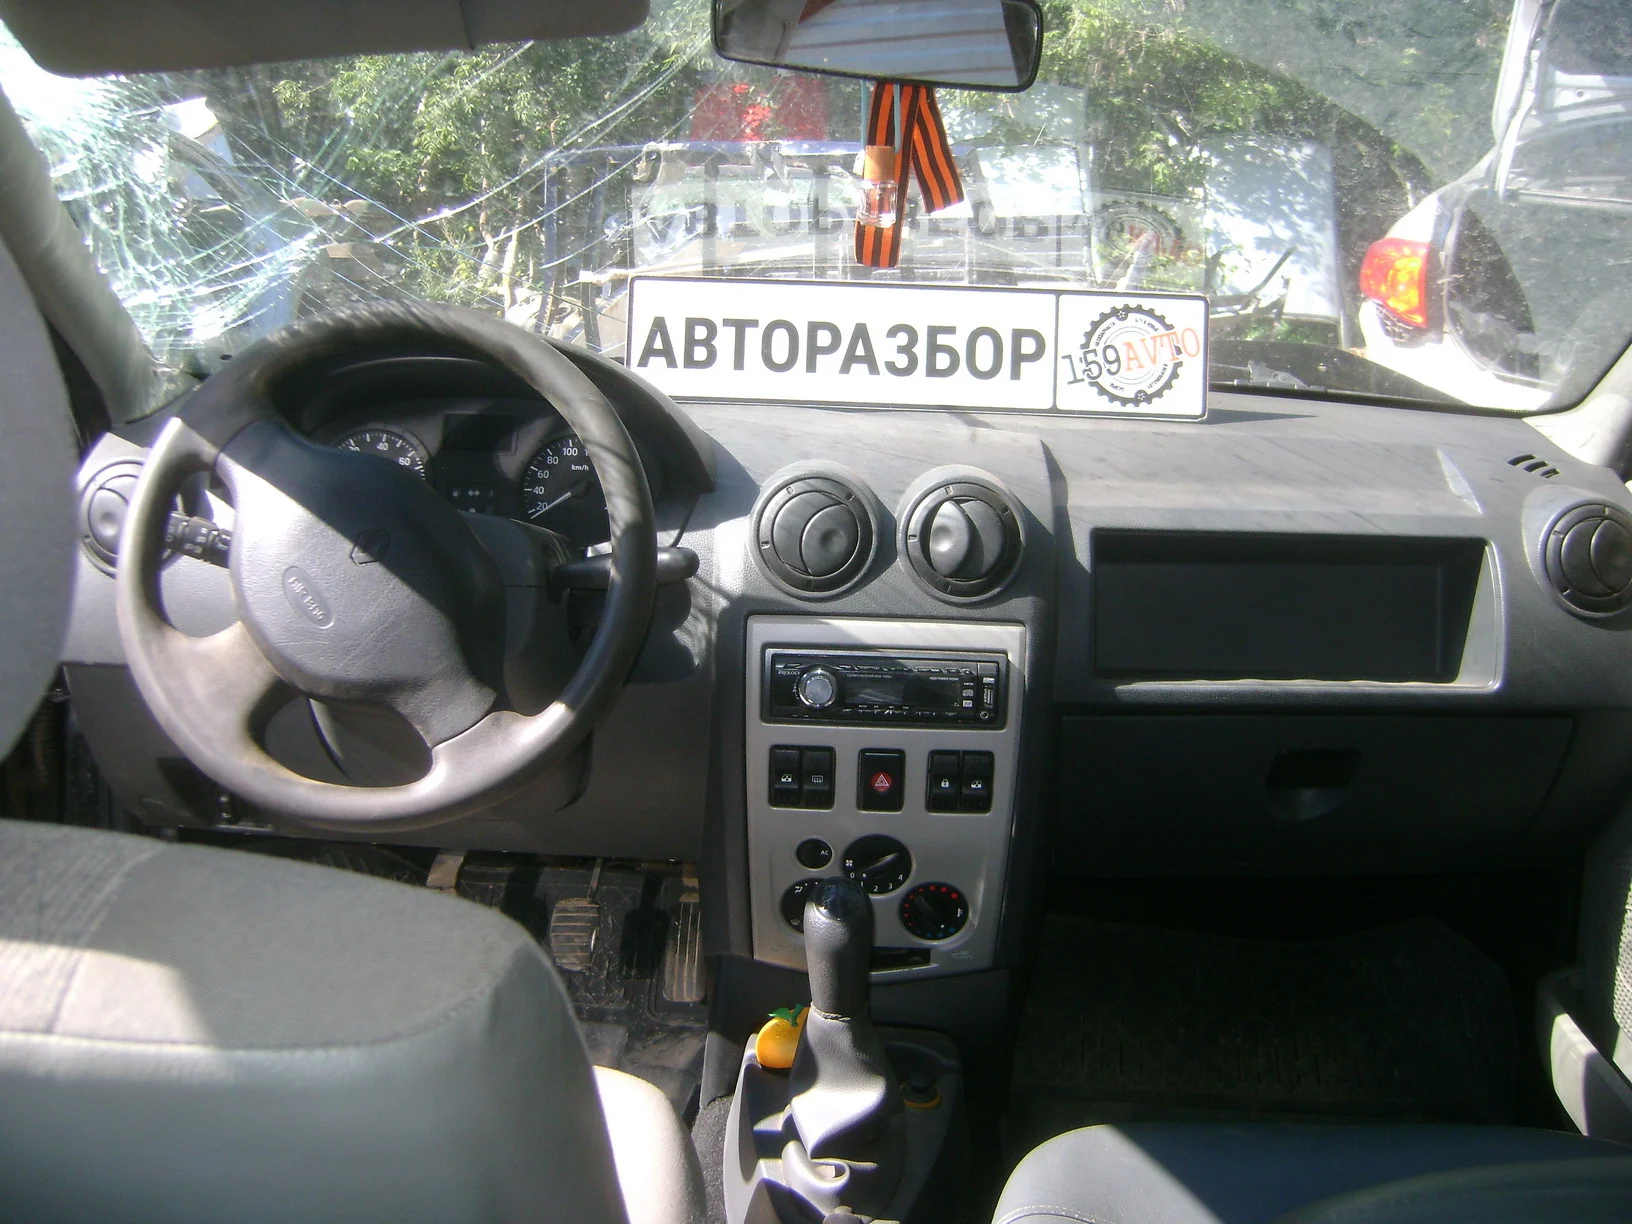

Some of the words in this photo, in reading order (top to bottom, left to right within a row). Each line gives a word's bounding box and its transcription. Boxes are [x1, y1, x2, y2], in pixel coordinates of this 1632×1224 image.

[636, 315, 1048, 382] АВТОРАЗБОР
[1061, 327, 1201, 385] 159AVTO
[377, 442, 389, 451] 40
[562, 447, 578, 456] 100
[398, 457, 411, 466] 60
[546, 456, 559, 465] 80
[537, 470, 550, 479] 60
[533, 486, 545, 495] 40
[536, 502, 548, 511] 20
